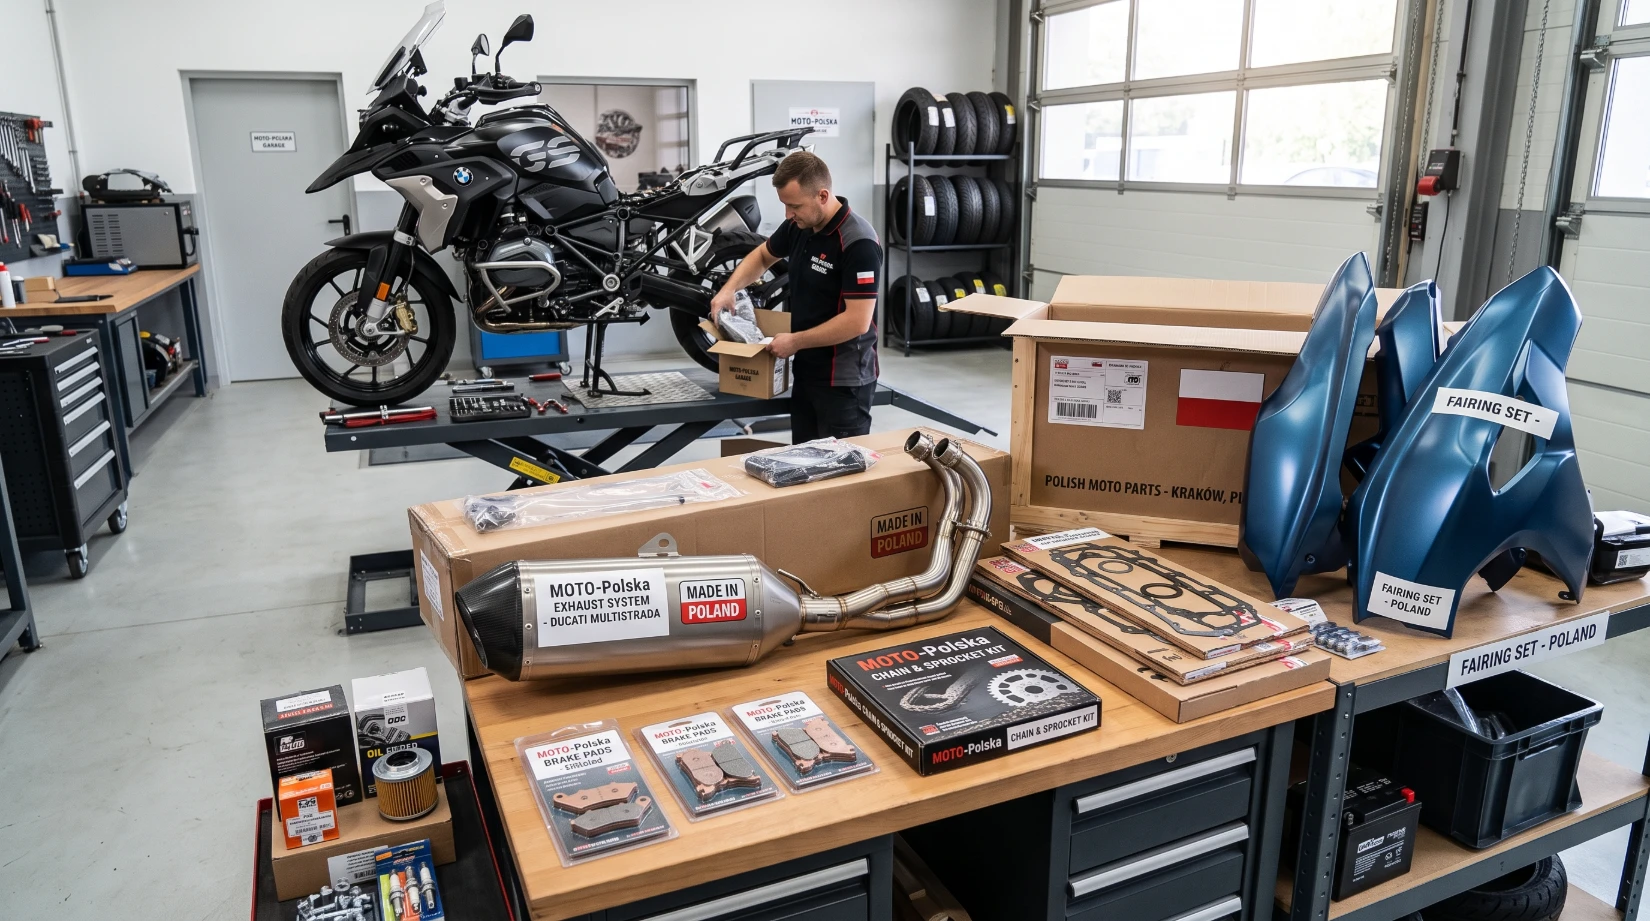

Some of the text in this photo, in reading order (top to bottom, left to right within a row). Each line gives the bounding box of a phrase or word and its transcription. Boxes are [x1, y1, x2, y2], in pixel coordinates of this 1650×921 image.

[791, 117, 838, 126] MOTO-POLSKA
[510, 135, 581, 173] GS
[1446, 396, 1502, 415] FAIRING
[1504, 406, 1533, 424] SET
[1045, 474, 1086, 490] POLISH
[1088, 479, 1122, 494] MOTO
[1124, 482, 1161, 497] PARTS
[1171, 486, 1227, 504] KRAKÓW,
[877, 511, 922, 535] MADE IN
[877, 530, 923, 554] POLAND
[550, 577, 651, 598] MOTO-Polska
[686, 583, 739, 600] MADE IN
[1381, 583, 1442, 605] FAIRING SET
[554, 595, 650, 613] EXHAUST SYSTEM
[688, 602, 740, 620] POLAND
[1390, 599, 1431, 617] POLAND
[550, 614, 588, 627] DUCATI
[590, 608, 661, 624] MULTISTRADA
[857, 636, 991, 672] MOTO-Polska
[1460, 647, 1512, 676] FAIRING
[1514, 639, 1539, 661] SET
[1549, 623, 1597, 651] POLAND
[871, 666, 912, 681] CHAIN
[911, 664, 924, 672] &
[923, 650, 986, 670] SPROCKET
[985, 644, 1007, 655] KIT
[654, 721, 717, 739] MOTO-Polska
[661, 733, 692, 745] BRAKE
[693, 727, 717, 738] PADS
[932, 712, 1095, 765] MOTO-Polska CHAIN & SPROCKET KIT
[367, 749, 384, 759] OIL
[536, 737, 611, 759] MOTO-Polska
[543, 753, 581, 767] BRAKE
[583, 746, 613, 759] PADS
